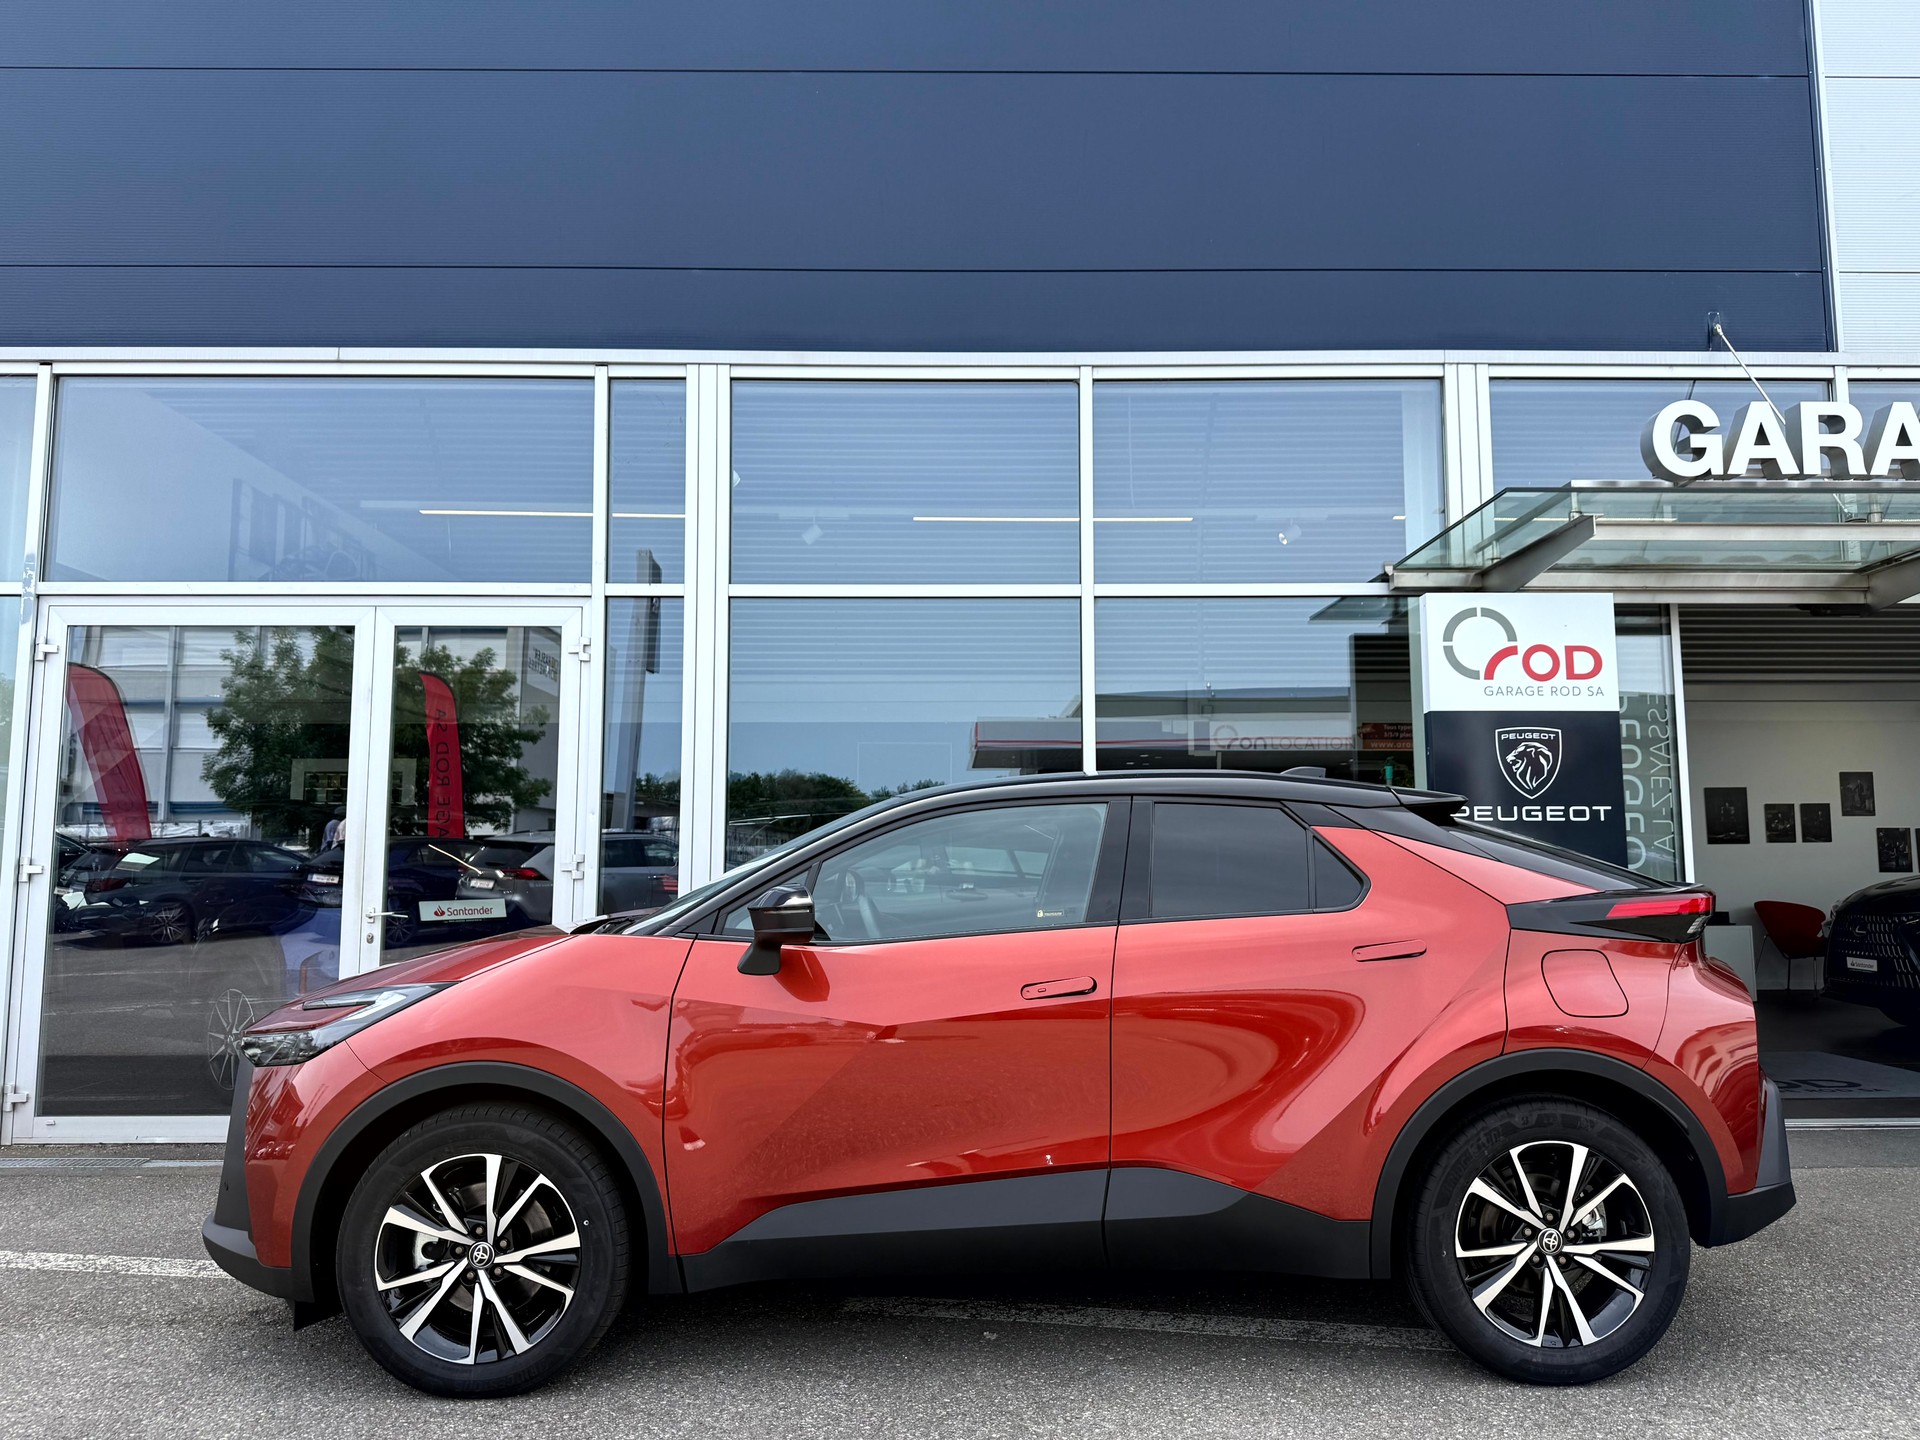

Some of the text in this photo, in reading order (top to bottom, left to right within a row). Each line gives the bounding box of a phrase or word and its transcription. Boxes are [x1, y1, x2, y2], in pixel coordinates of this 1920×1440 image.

[1648, 399, 1920, 477] GARA
[1483, 685, 1605, 697] GARAGE ROD SA
[1501, 732, 1556, 741] PEUGEOT
[446, 906, 494, 917] Santander
